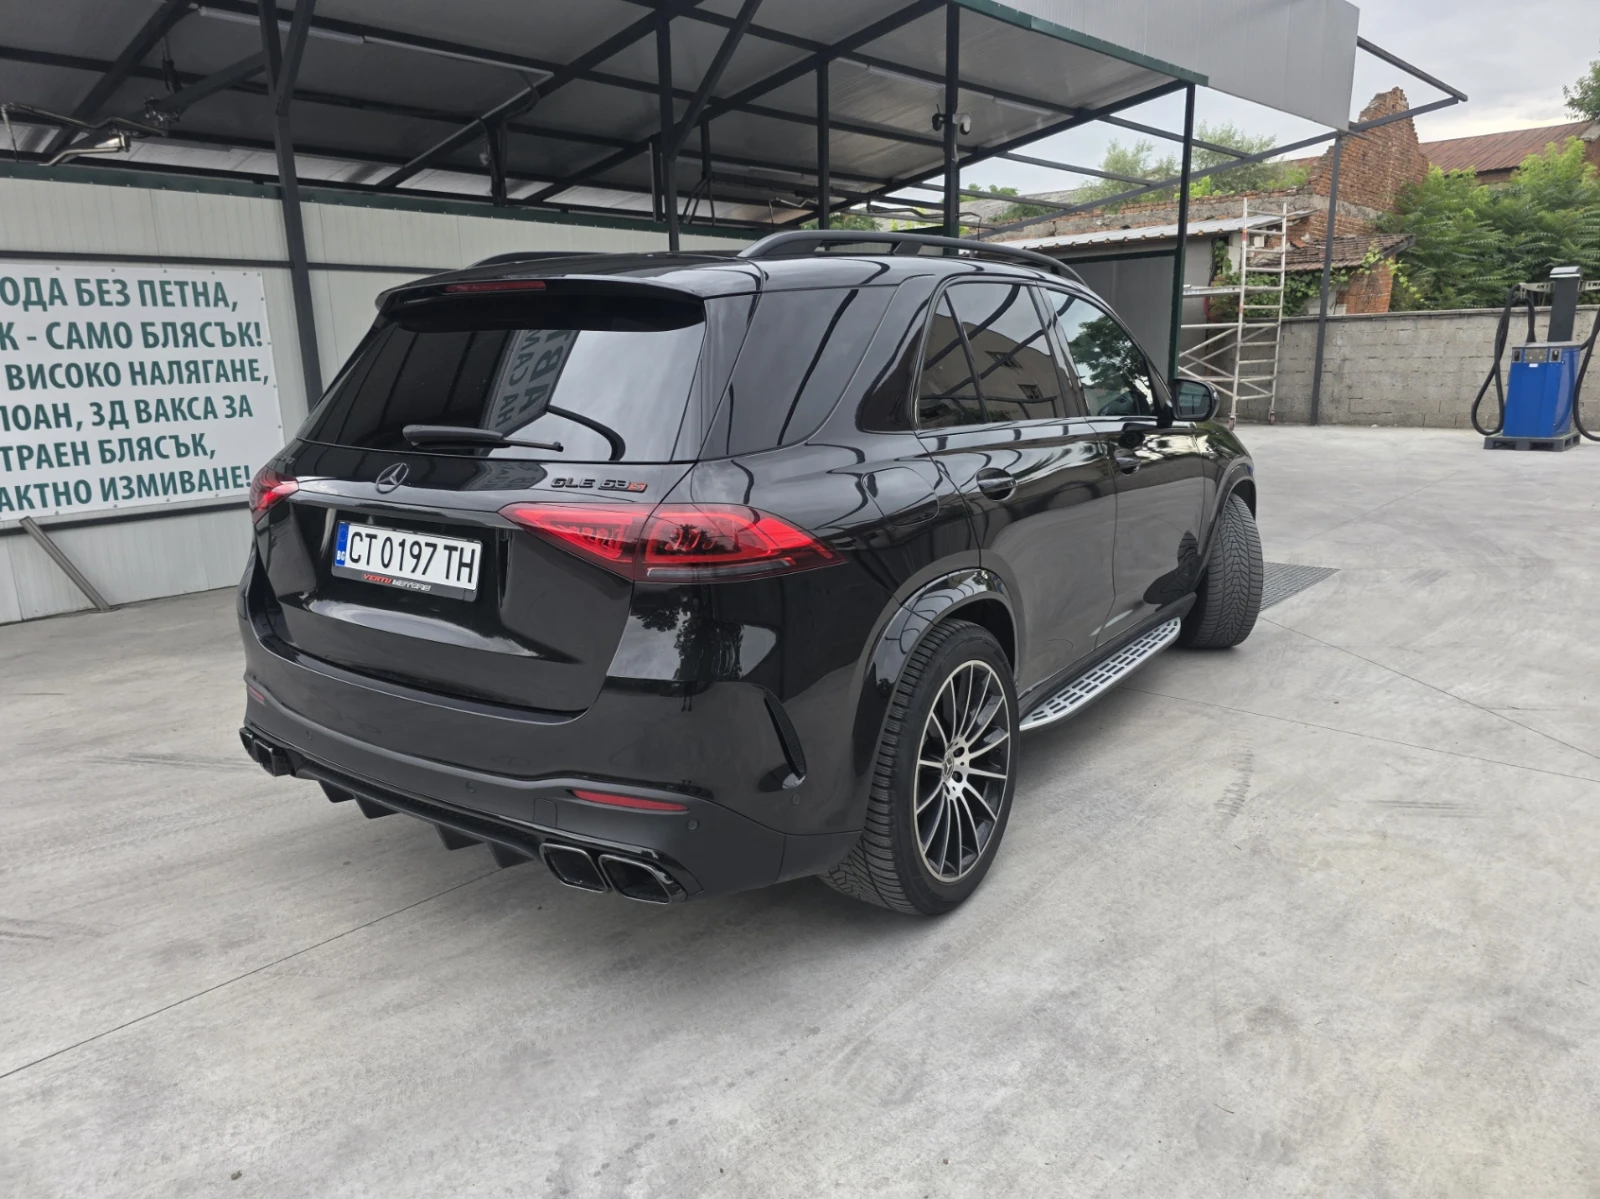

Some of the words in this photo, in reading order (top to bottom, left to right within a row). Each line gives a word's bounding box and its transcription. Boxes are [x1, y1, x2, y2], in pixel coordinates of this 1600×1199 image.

[0, 277, 68, 312] ОДА
[74, 278, 131, 307] БЕЗ
[137, 280, 238, 312] ПЕТНА,
[45, 321, 133, 350] САМО
[140, 322, 263, 349] БЛЯСЪК!
[5, 361, 121, 391] ВИСОКО
[129, 358, 269, 386] НАЛЯГАНЕ,
[135, 396, 218, 424] ВАКСА
[222, 394, 254, 419] ЗА
[0, 441, 91, 472] ТРАЕН
[98, 433, 216, 464] БЛЯСЪК,
[0, 479, 92, 513] АКТНО
[99, 465, 252, 502] ИЗМИВАНЕ!
[550, 477, 596, 489] GLE
[336, 550, 346, 561] BG
[349, 531, 378, 566] CT
[380, 536, 438, 576] 0197
[443, 544, 476, 583] TH
